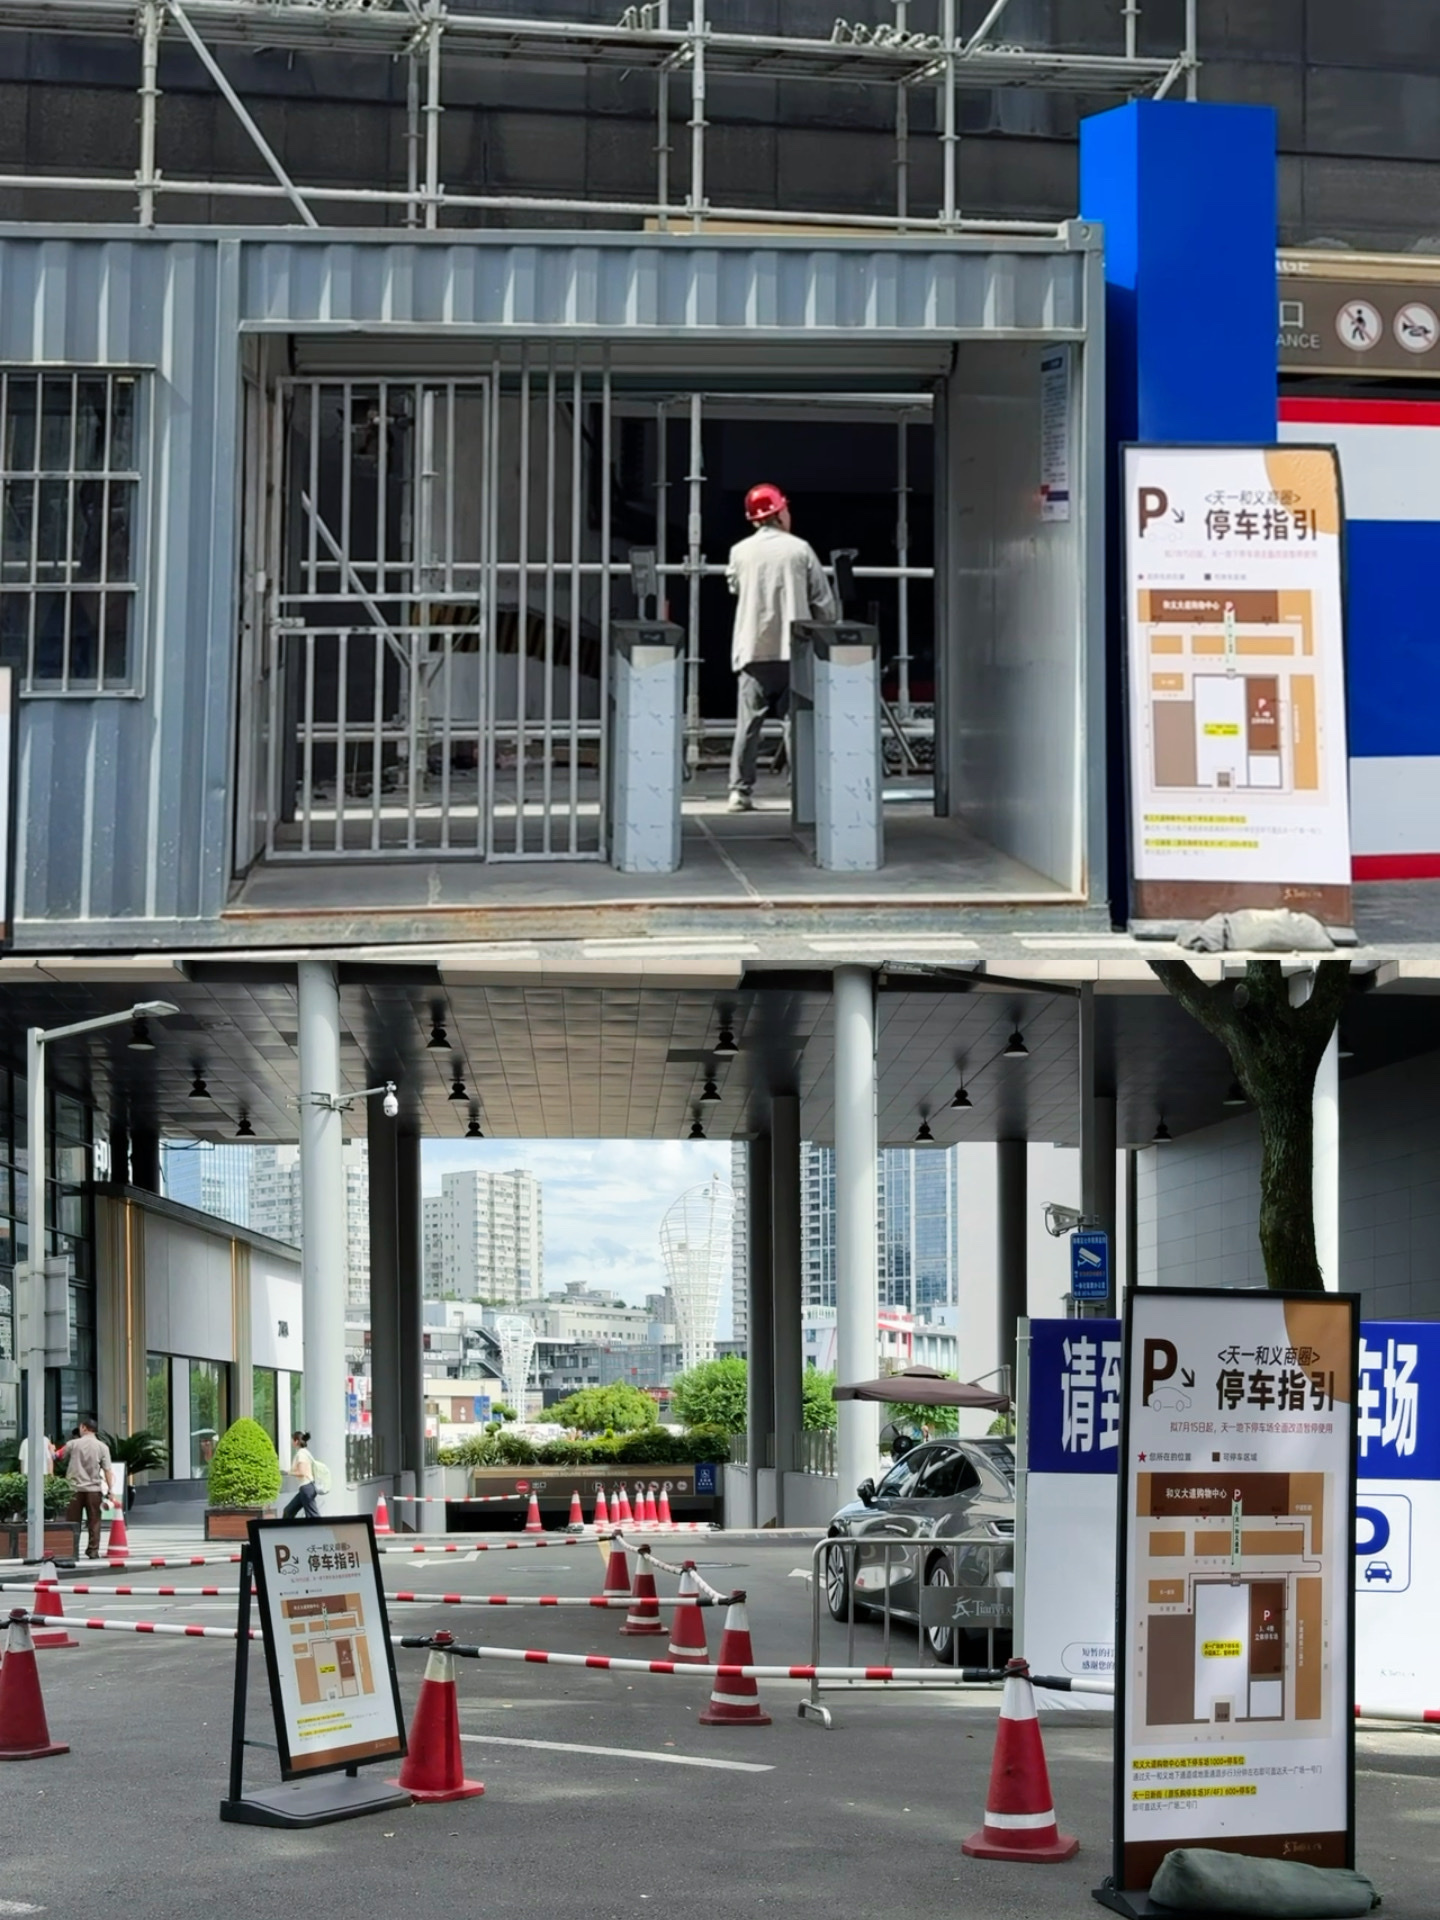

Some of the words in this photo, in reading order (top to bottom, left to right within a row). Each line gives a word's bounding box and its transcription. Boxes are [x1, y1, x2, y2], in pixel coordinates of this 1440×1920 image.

[1138, 487, 1168, 538] P
[1204, 508, 1317, 541] 停车指引
[1142, 1338, 1178, 1407] P
[1216, 1369, 1334, 1412] 停车指引
[1165, 1487, 1228, 1499] 和义大道购物中心
[1233, 1488, 1242, 1500] P
[274, 1544, 290, 1574] P
[307, 1552, 360, 1572] 停车指引
[1263, 1609, 1271, 1621] P
[1082, 1660, 1114, 1670] 感谢您的
